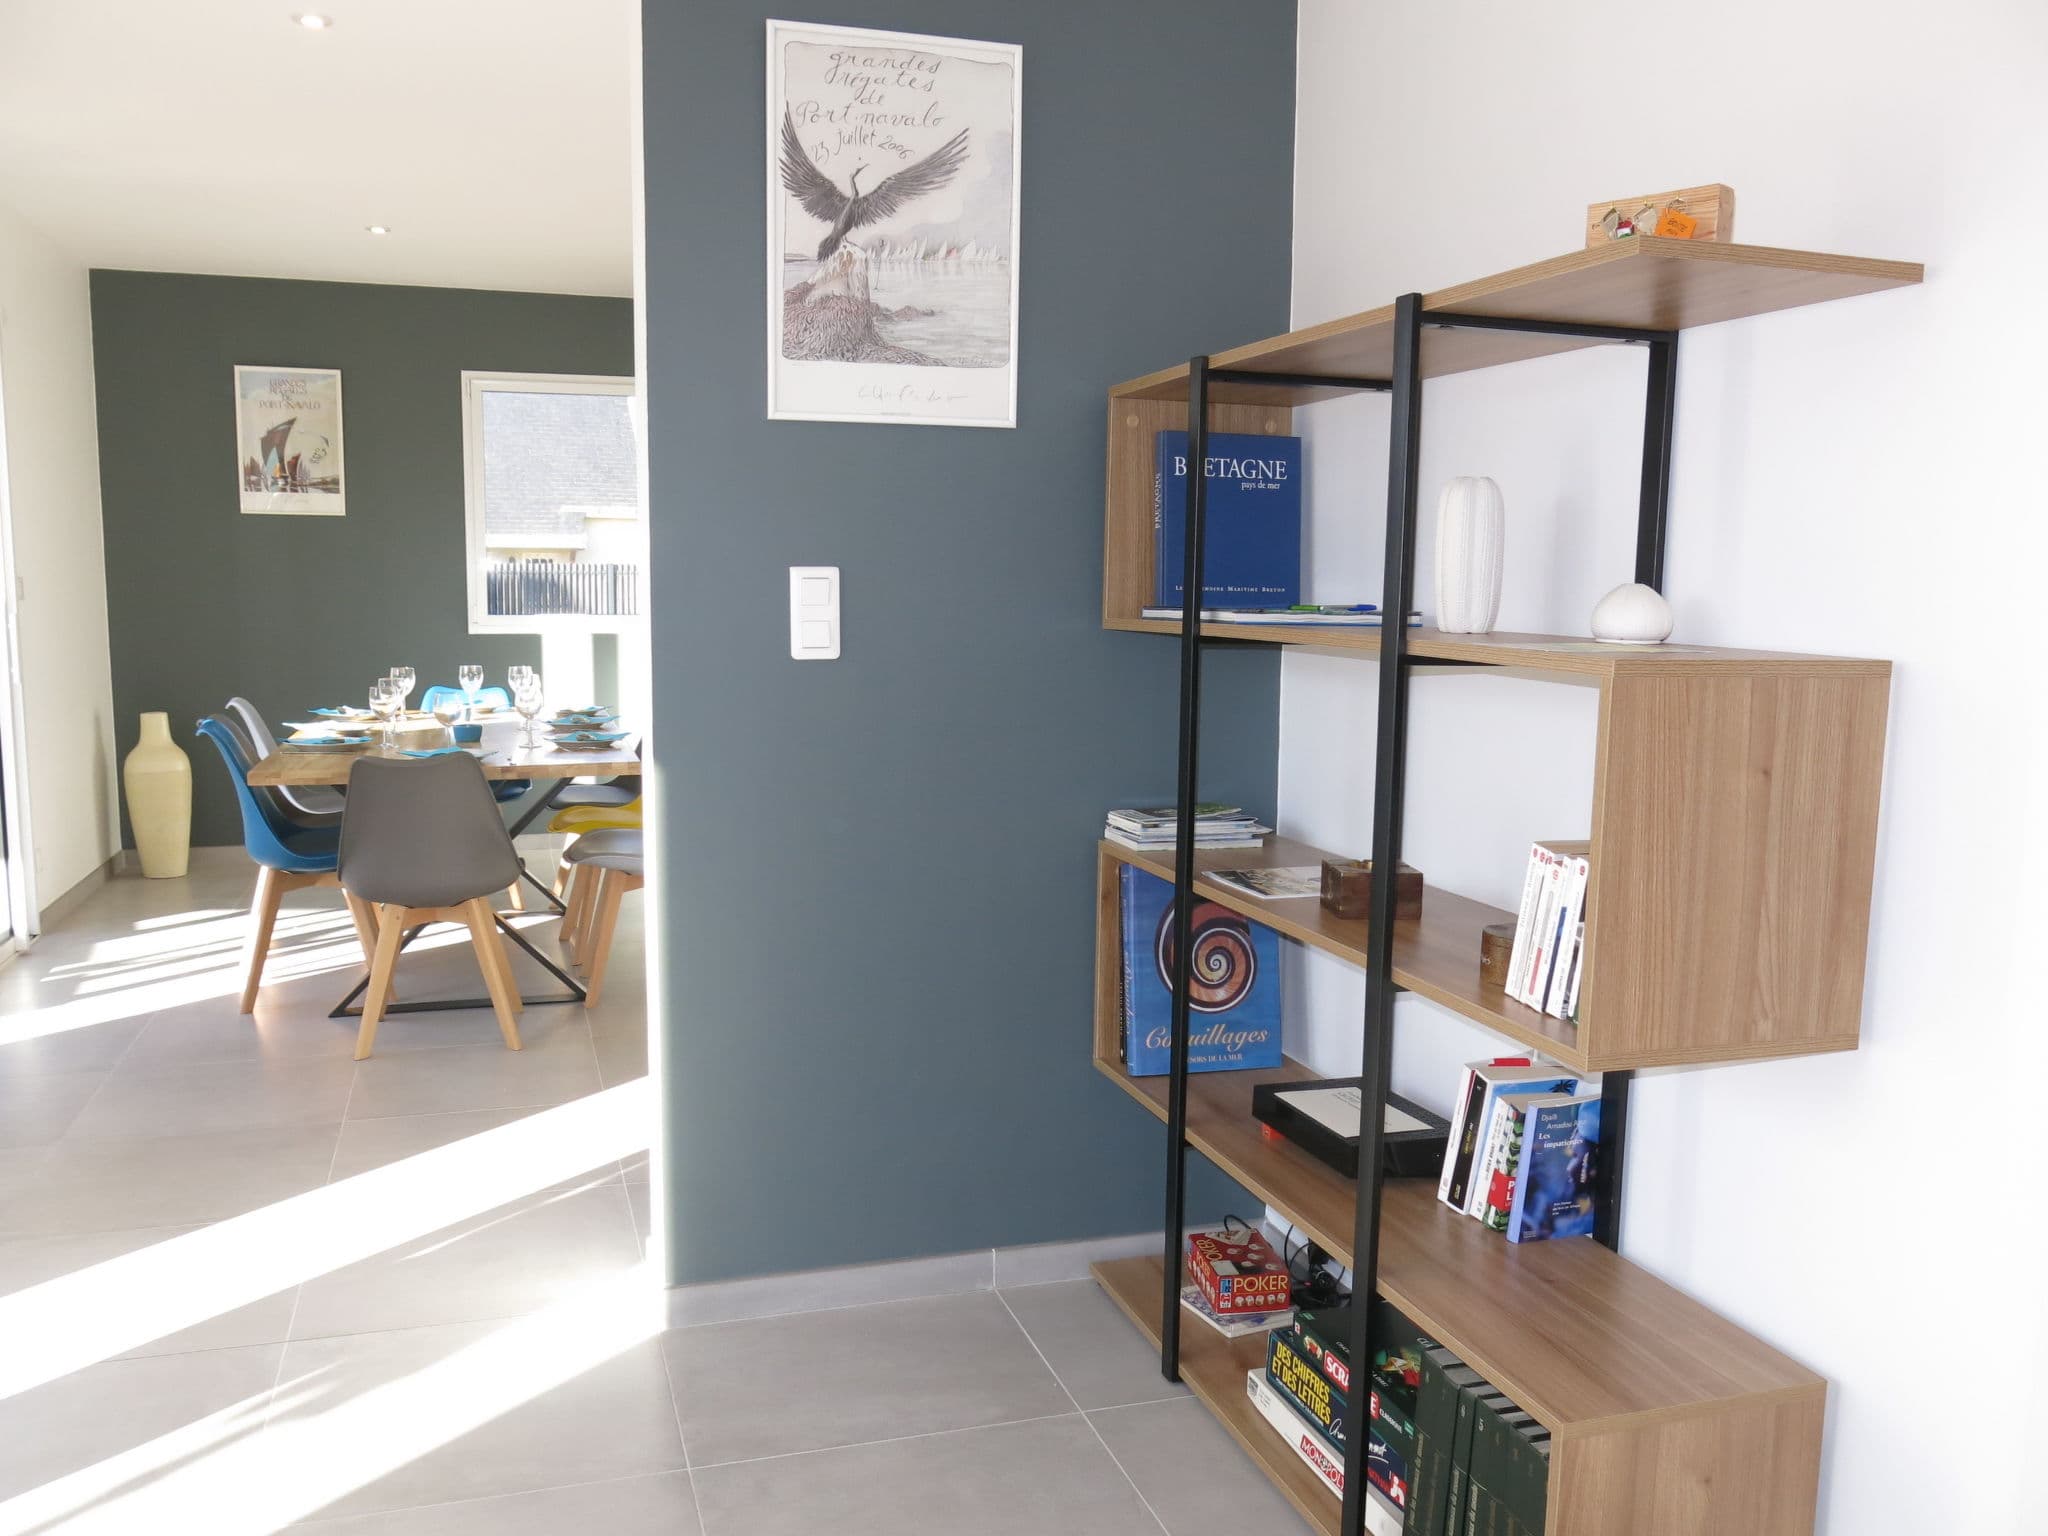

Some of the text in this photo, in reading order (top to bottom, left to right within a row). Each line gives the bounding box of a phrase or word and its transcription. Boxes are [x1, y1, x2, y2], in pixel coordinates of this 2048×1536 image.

[878, 135, 916, 161] 2006
[1174, 456, 1287, 480] BETAGNE
[1241, 480, 1280, 491] pays de mer
[1145, 1023, 1269, 1052] Couillages
[1538, 1132, 1551, 1140] Les
[1196, 1239, 1222, 1261] OKER
[1233, 1275, 1289, 1292] POKER
[1276, 1341, 1290, 1364] DES
[1292, 1356, 1331, 1403] CHIFFRES
[1272, 1355, 1282, 1376] ET
[1282, 1363, 1297, 1390] DES
[1297, 1378, 1331, 1425] LETTRES
